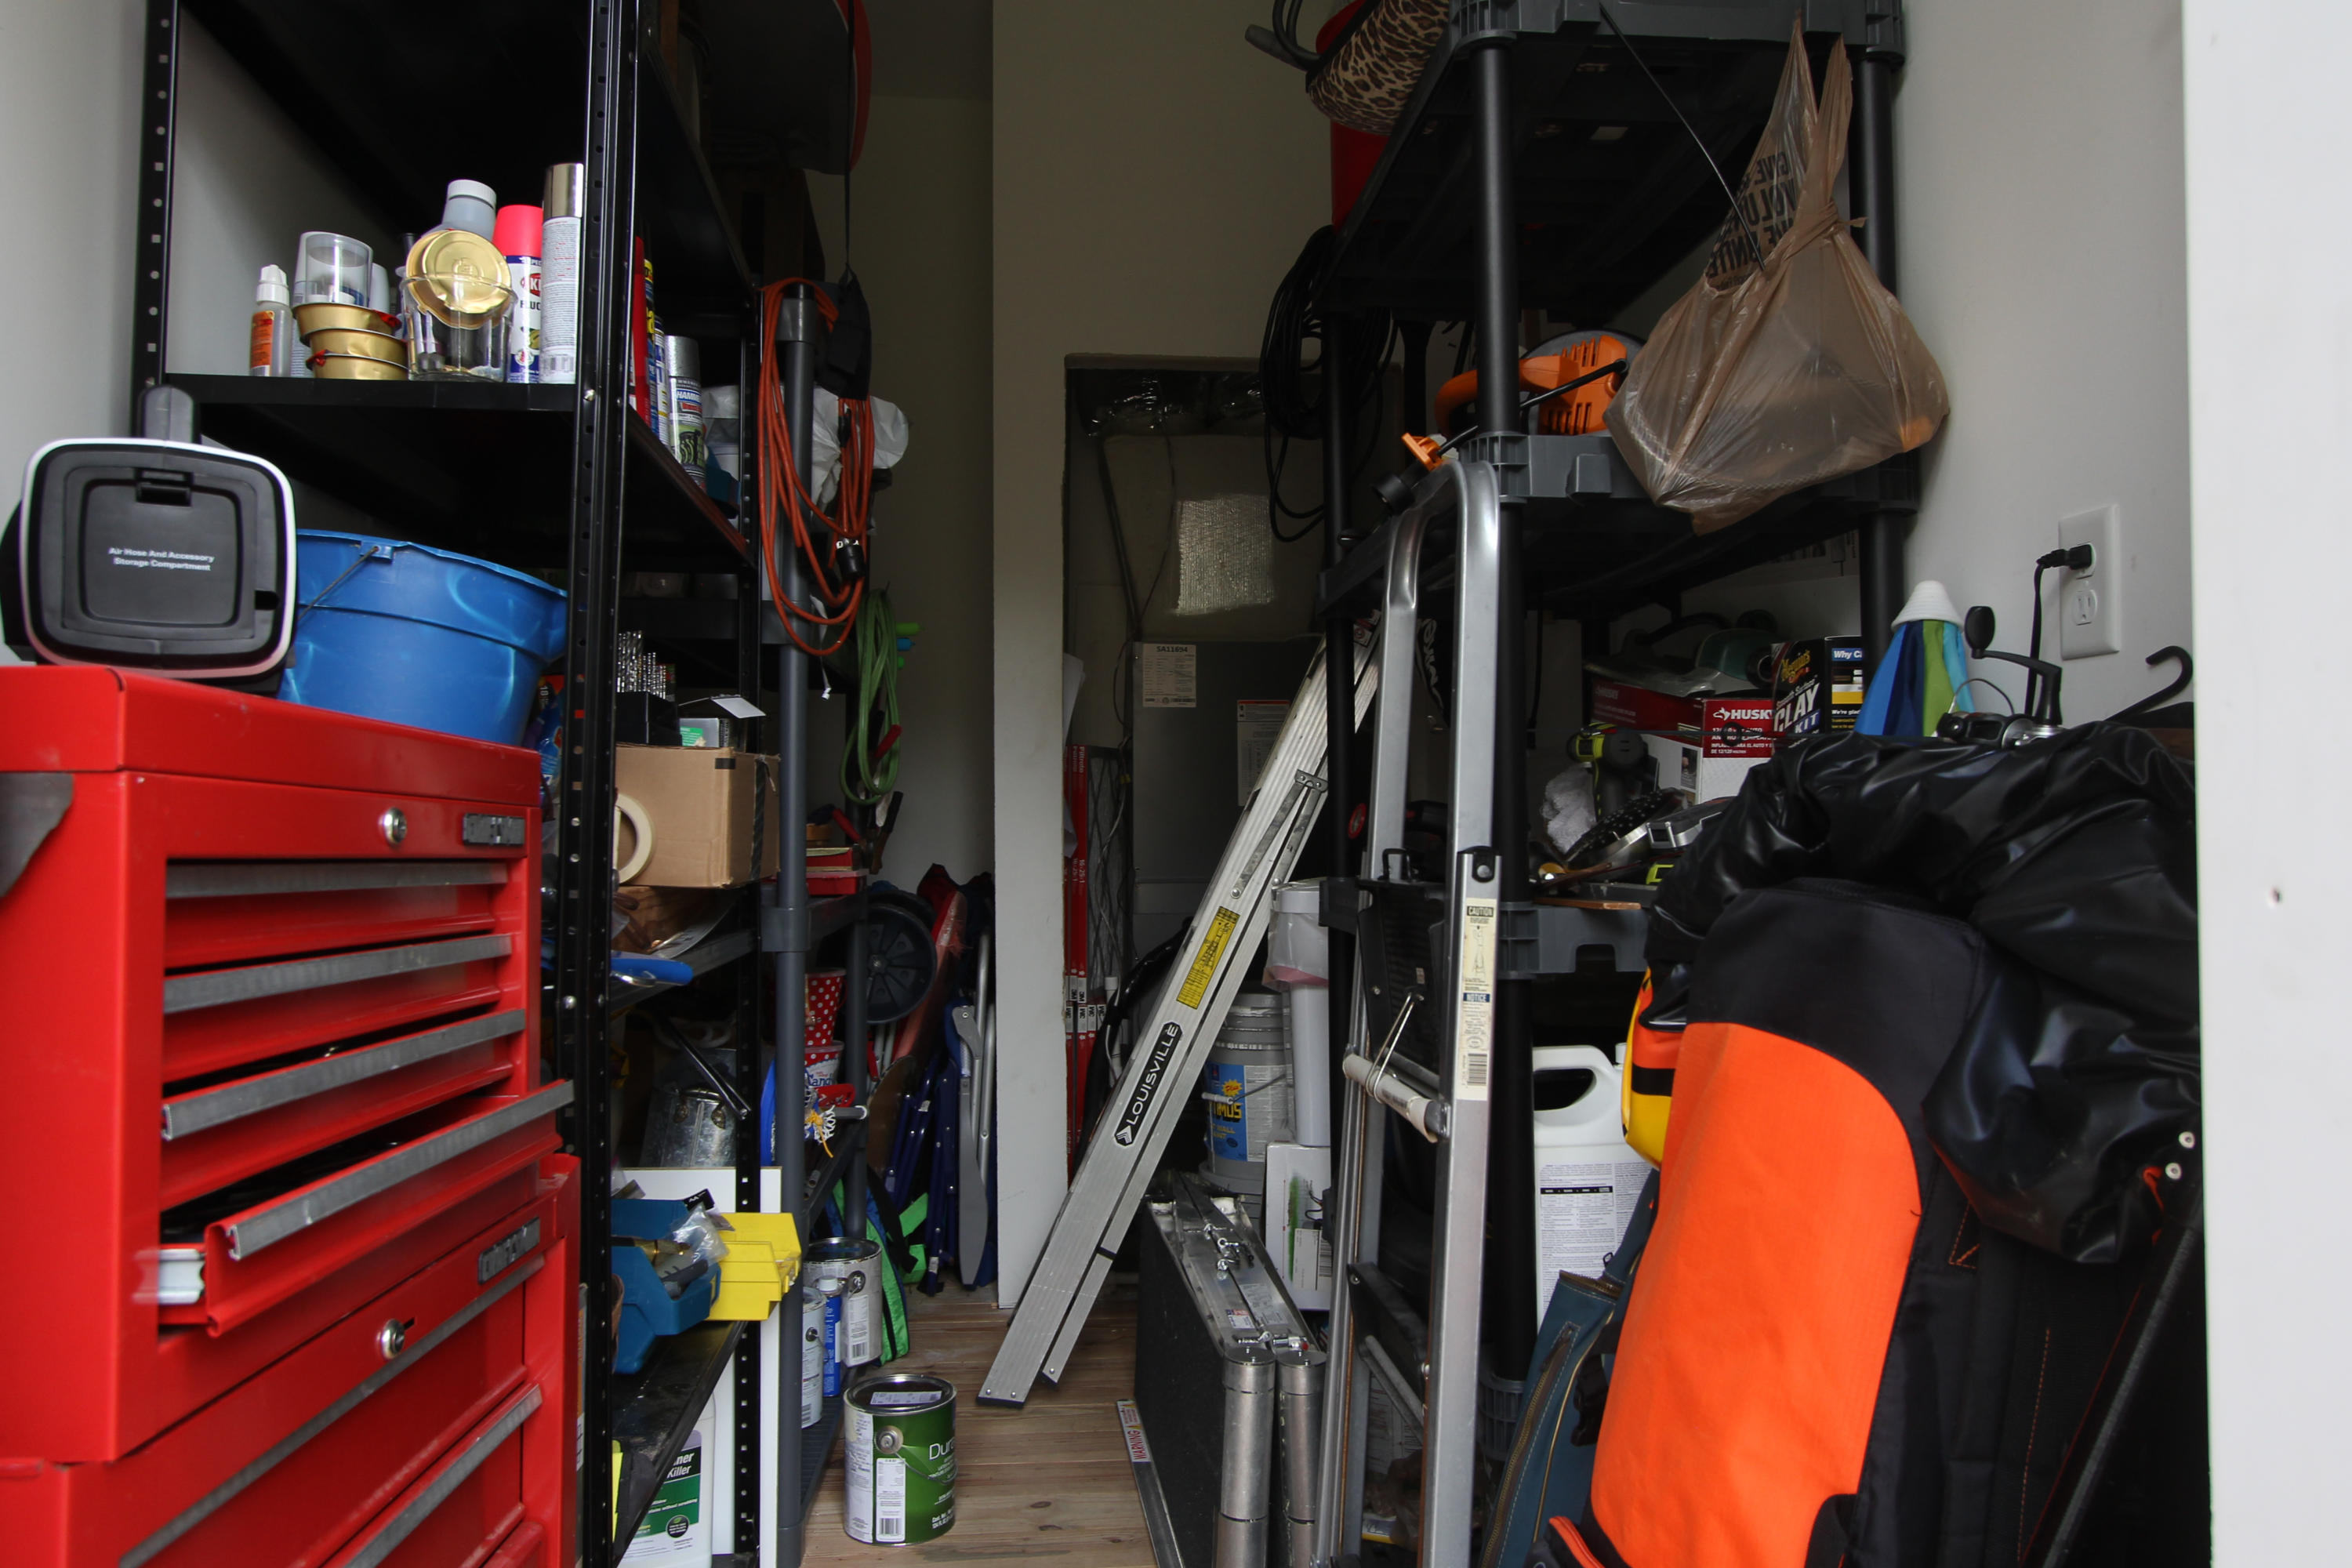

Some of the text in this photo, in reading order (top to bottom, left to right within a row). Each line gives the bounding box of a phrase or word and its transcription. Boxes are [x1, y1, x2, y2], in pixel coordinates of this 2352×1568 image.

[169, 552, 214, 563] Accessory
[114, 557, 211, 571] Storage Compartment
[1834, 650, 1852, 659] Why
[1773, 682, 1820, 732] CLAY
[1795, 712, 1819, 734] KIT
[1079, 991, 1085, 1002] 3M
[1080, 1008, 1085, 1019] 3M
[1089, 1006, 1095, 1017] 3M
[1098, 1005, 1105, 1017] 3M
[1126, 1024, 1178, 1125] LOUISVILLE
[1127, 1430, 1147, 1460] WARNING
[673, 1453, 695, 1465] ner
[667, 1465, 691, 1479] Killer
